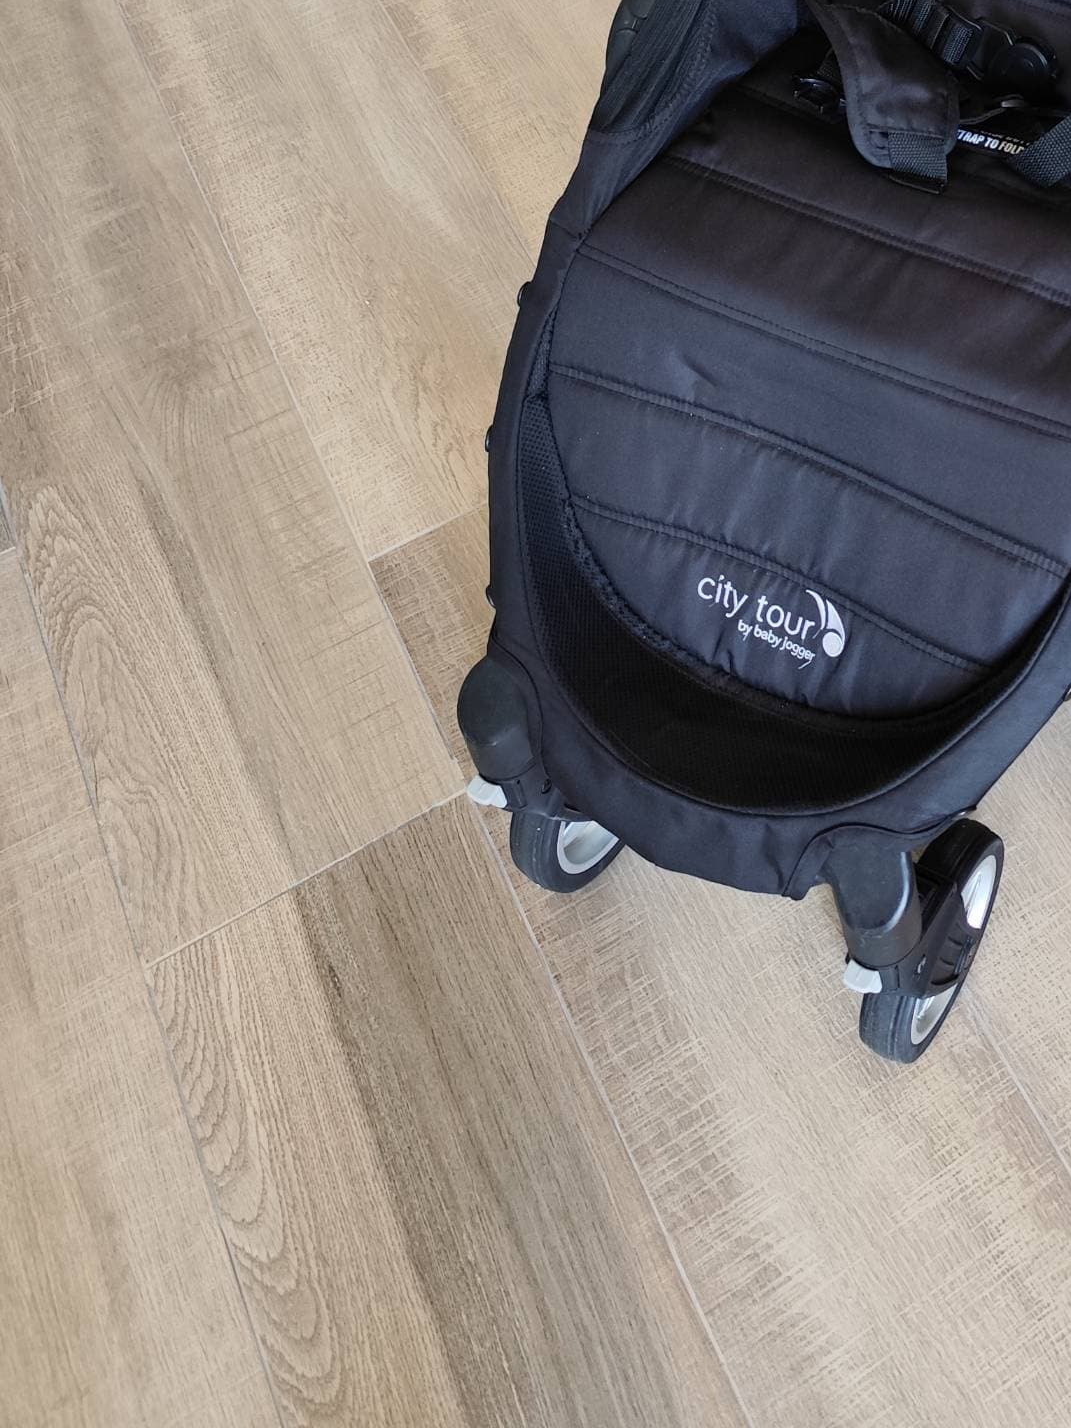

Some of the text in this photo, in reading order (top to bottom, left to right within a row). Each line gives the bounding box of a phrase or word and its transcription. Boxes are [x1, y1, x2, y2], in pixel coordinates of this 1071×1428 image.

[957, 129, 985, 145] TRAP
[984, 137, 1000, 149] TO
[697, 574, 816, 641] city tour
[738, 619, 816, 661] by baby jogger
